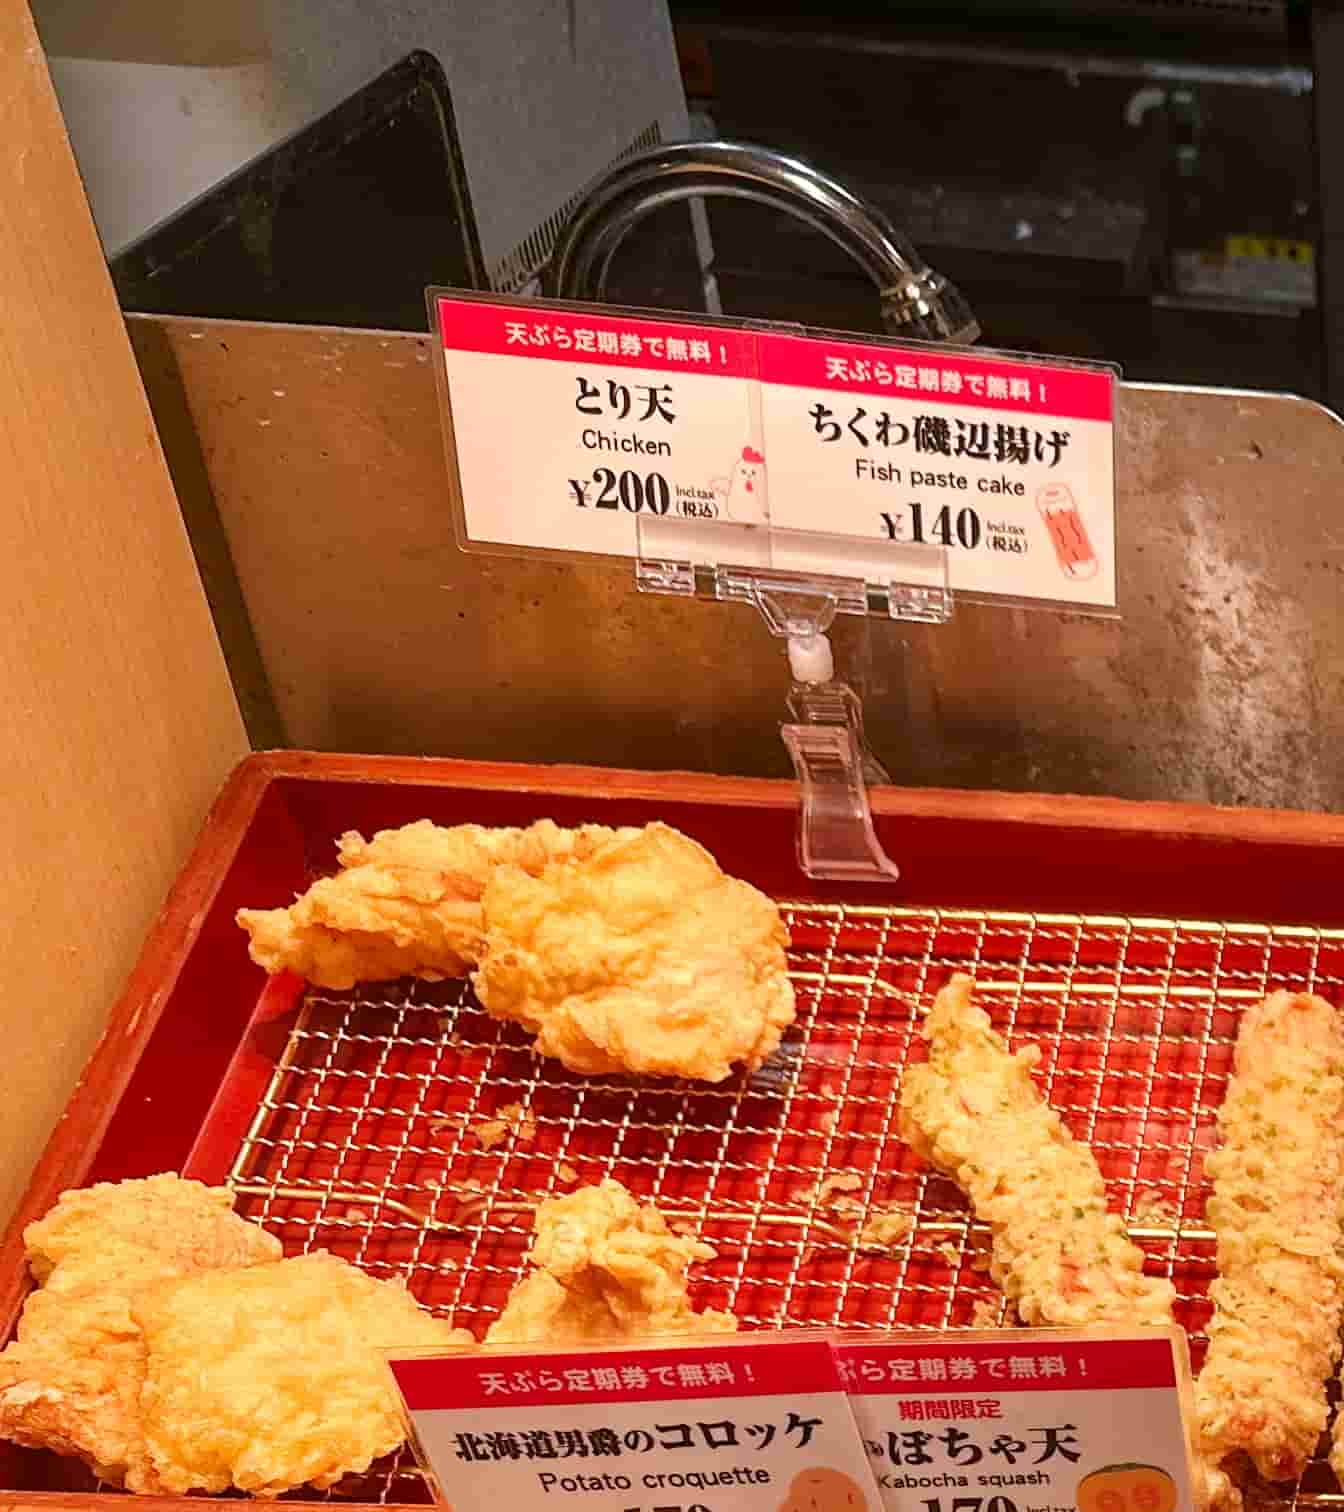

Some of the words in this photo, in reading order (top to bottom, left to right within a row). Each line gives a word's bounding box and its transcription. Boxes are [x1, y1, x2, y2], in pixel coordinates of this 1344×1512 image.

[575, 377, 677, 424] とり天
[582, 429, 672, 456] Chicken
[808, 403, 1071, 468] ちくわ磯辺揚げ
[568, 467, 671, 516] ¥200
[856, 458, 901, 482] Fish
[910, 469, 968, 490] paste
[977, 475, 1025, 496] cake
[880, 502, 980, 549] ¥140
[478, 1362, 755, 1395] 天ぷら定期券で無料!
[835, 1355, 1088, 1382] ぷら定期券で無料!
[897, 1398, 1003, 1421] 期間限定
[450, 1412, 823, 1462] 北海道男爵のコロッケ
[538, 1472, 631, 1493] Potato
[642, 1466, 770, 1490] croquette
[879, 1472, 968, 1489] Kabocha
[978, 1471, 1050, 1488] squash
